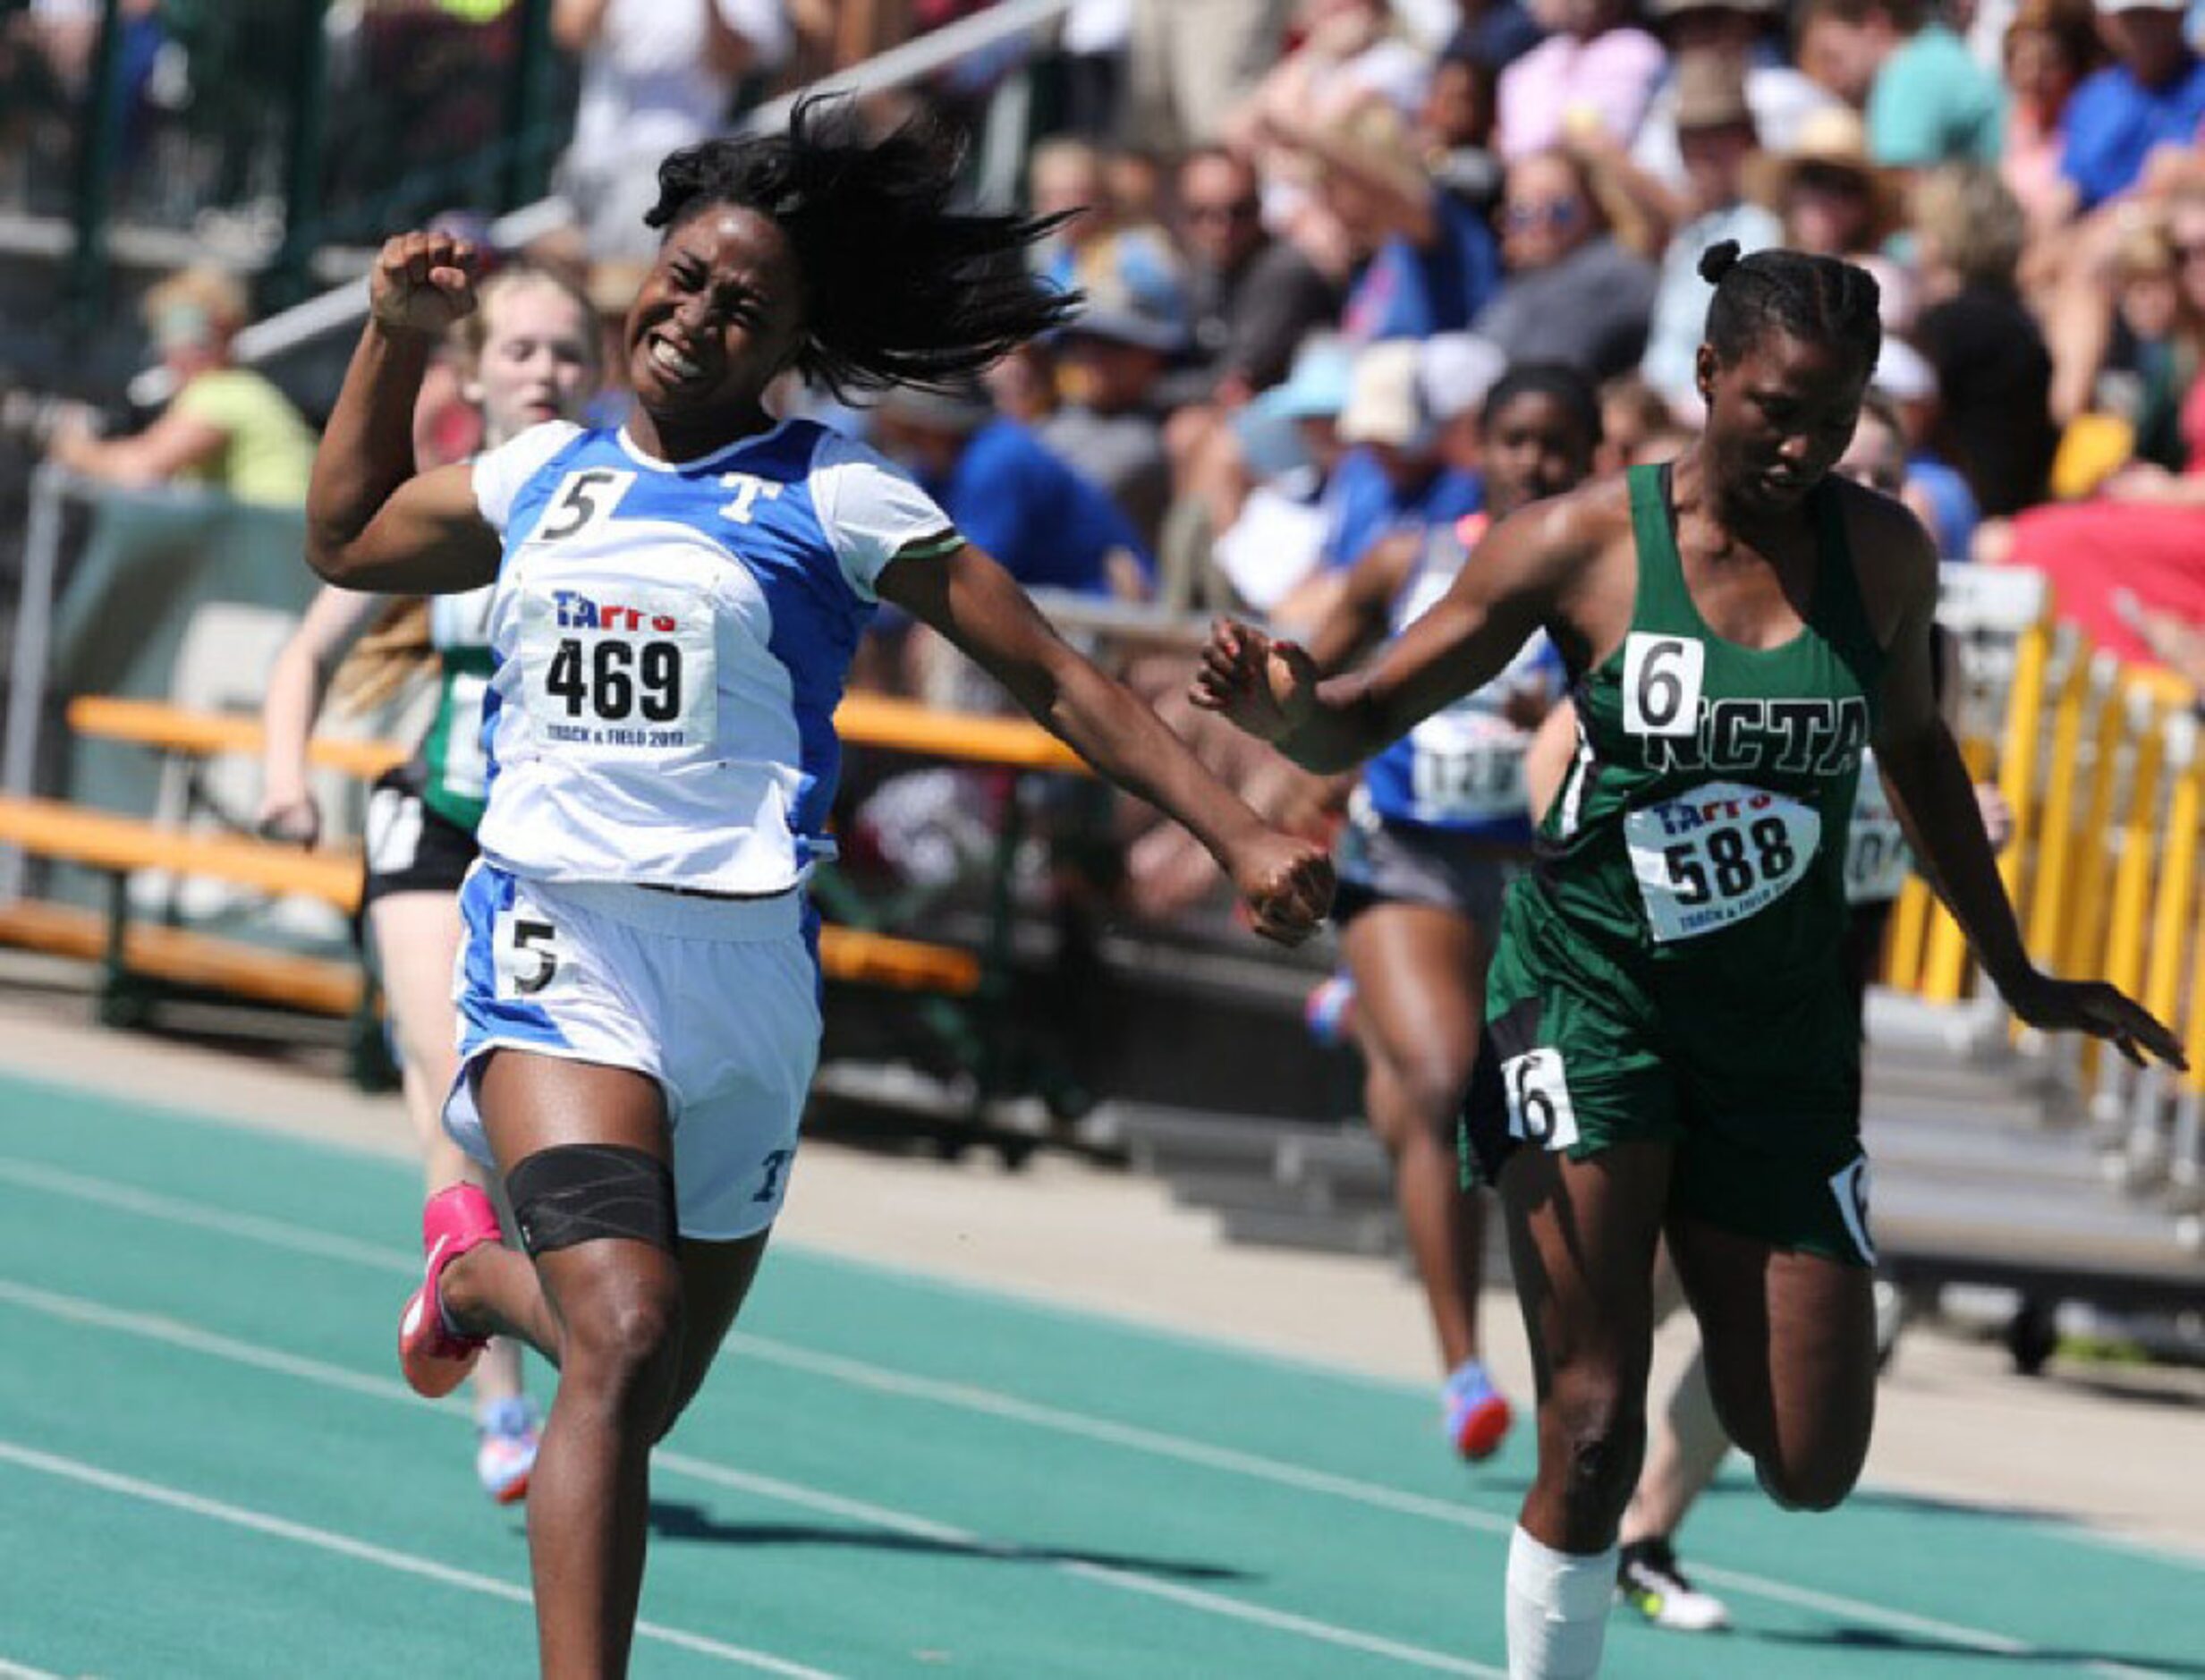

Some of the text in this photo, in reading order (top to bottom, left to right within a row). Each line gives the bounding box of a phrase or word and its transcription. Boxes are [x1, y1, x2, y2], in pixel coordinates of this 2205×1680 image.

[542, 472, 615, 540] 5
[718, 472, 784, 524] T
[547, 638, 682, 722] 469
[1638, 641, 1683, 727] 6
[547, 725, 589, 742] TRACK
[594, 730, 605, 744] &
[608, 728, 647, 746] FIELD
[1643, 695, 1870, 776] NCTA
[1664, 817, 1794, 905] 588
[513, 919, 556, 994] 5
[1516, 1054, 1556, 1145] 6
[753, 1149, 796, 1202] T
